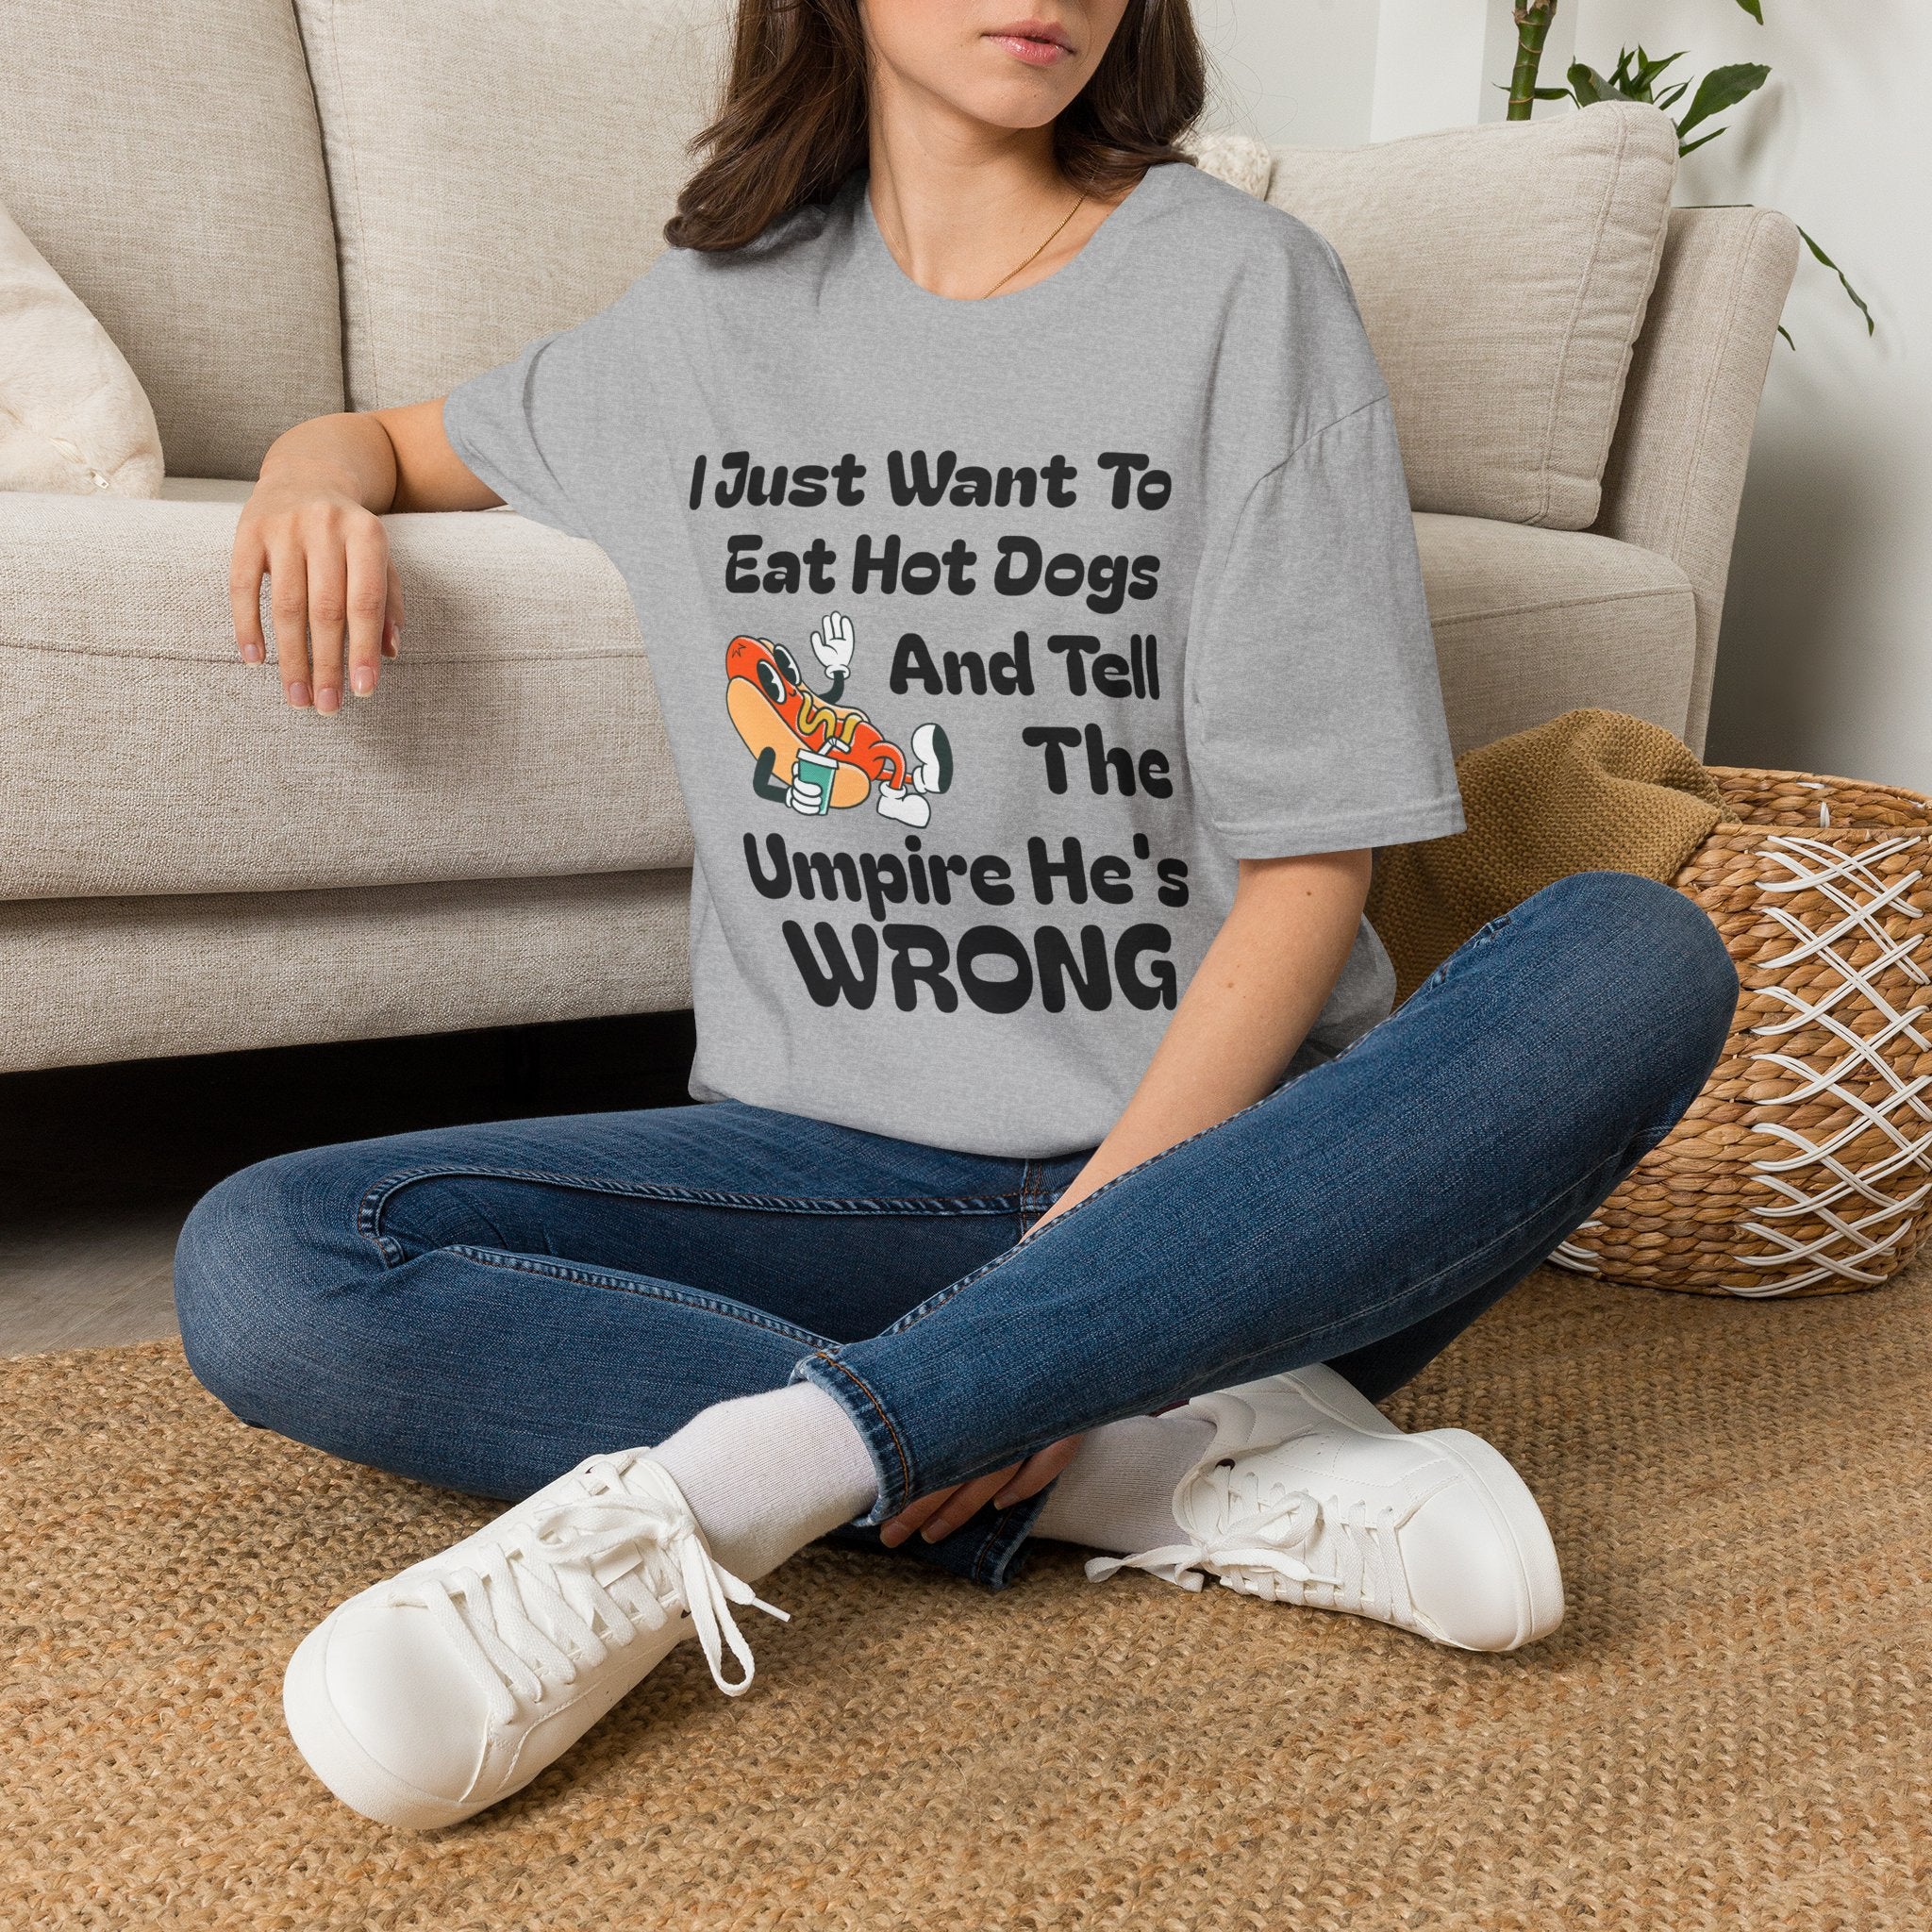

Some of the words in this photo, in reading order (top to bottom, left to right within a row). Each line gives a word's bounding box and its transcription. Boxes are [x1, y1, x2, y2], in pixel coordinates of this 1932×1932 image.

[689, 454, 708, 510] I
[714, 450, 867, 508] Just
[887, 450, 1078, 509] Want
[1097, 451, 1173, 511] To
[724, 534, 837, 595] Eat
[851, 534, 977, 596] Hot
[993, 535, 1161, 615] Dogs
[889, 632, 1036, 696] And
[1046, 633, 1160, 702] Tell
[1022, 723, 1174, 800] The
[742, 832, 1015, 924] Umpire
[1026, 832, 1190, 908] He's
[781, 920, 1178, 1015] WRONG
